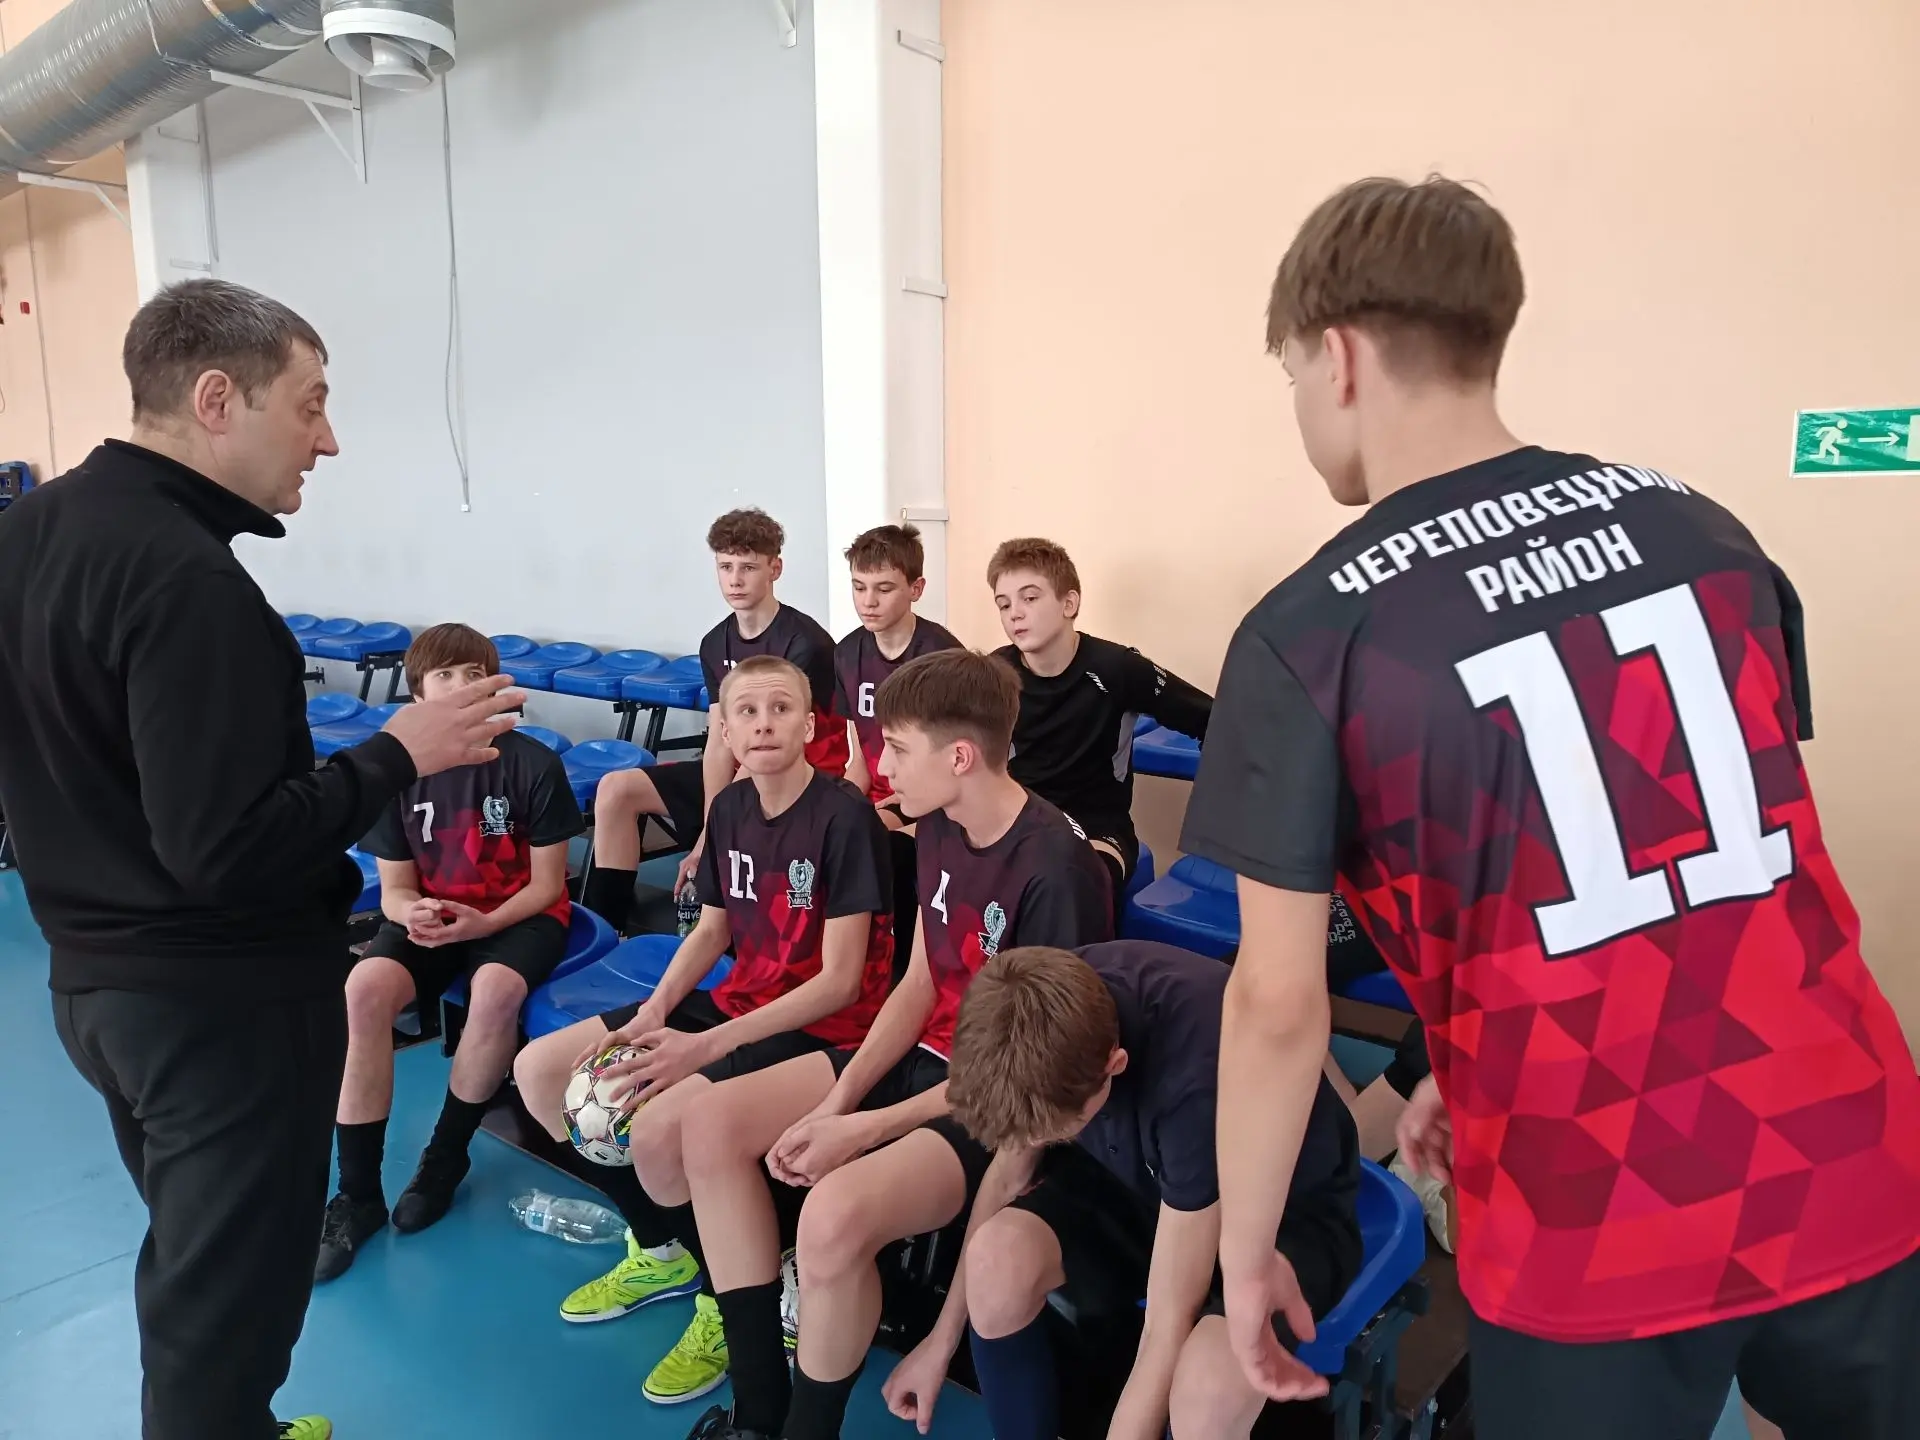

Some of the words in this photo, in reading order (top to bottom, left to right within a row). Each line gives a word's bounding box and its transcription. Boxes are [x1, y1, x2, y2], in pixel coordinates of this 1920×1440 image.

[1465, 523, 1644, 613] РАЙОН
[857, 682, 875, 718] 6
[1454, 583, 1793, 956] 11
[413, 801, 435, 843] 7
[930, 869, 951, 926] 4
